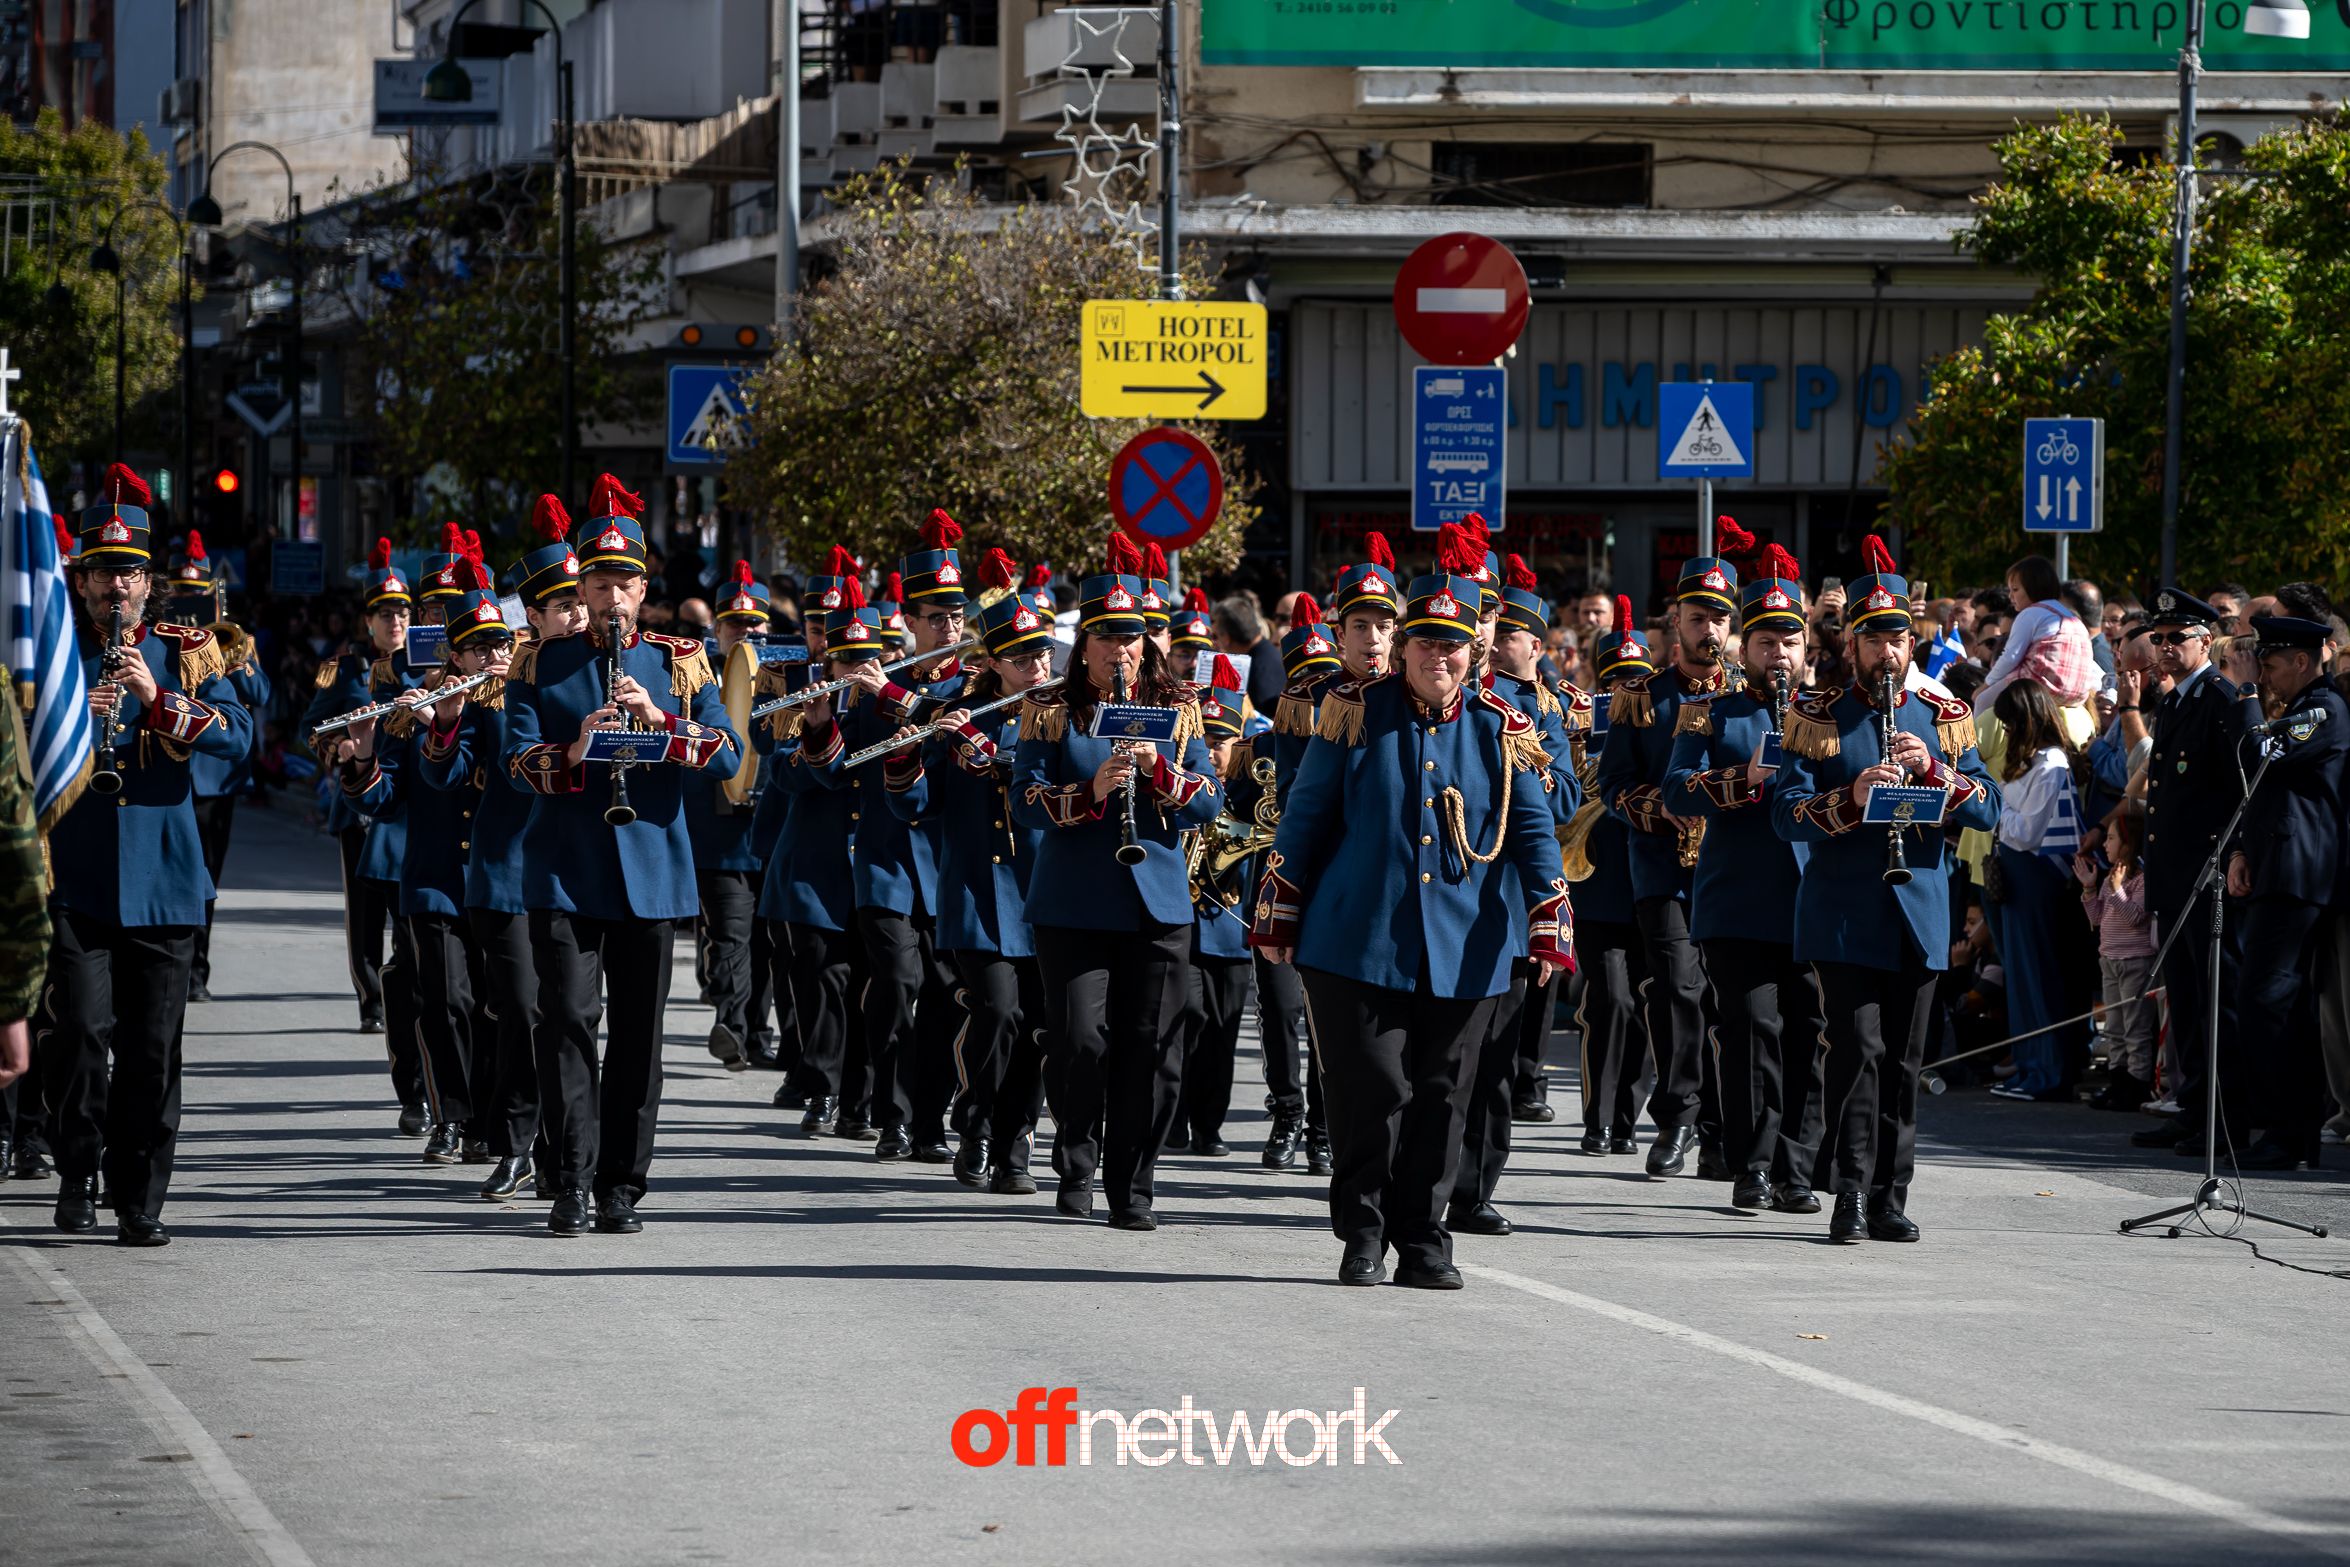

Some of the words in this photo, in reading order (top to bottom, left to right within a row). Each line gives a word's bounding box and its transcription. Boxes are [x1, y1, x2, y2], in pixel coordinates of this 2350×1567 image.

[1824, 0, 2240, 41] Φροντιστηρο
[1159, 316, 1253, 338] HOTEL
[1096, 340, 1254, 363] METROPOL
[1429, 481, 1486, 502] ΤΑΞΙ
